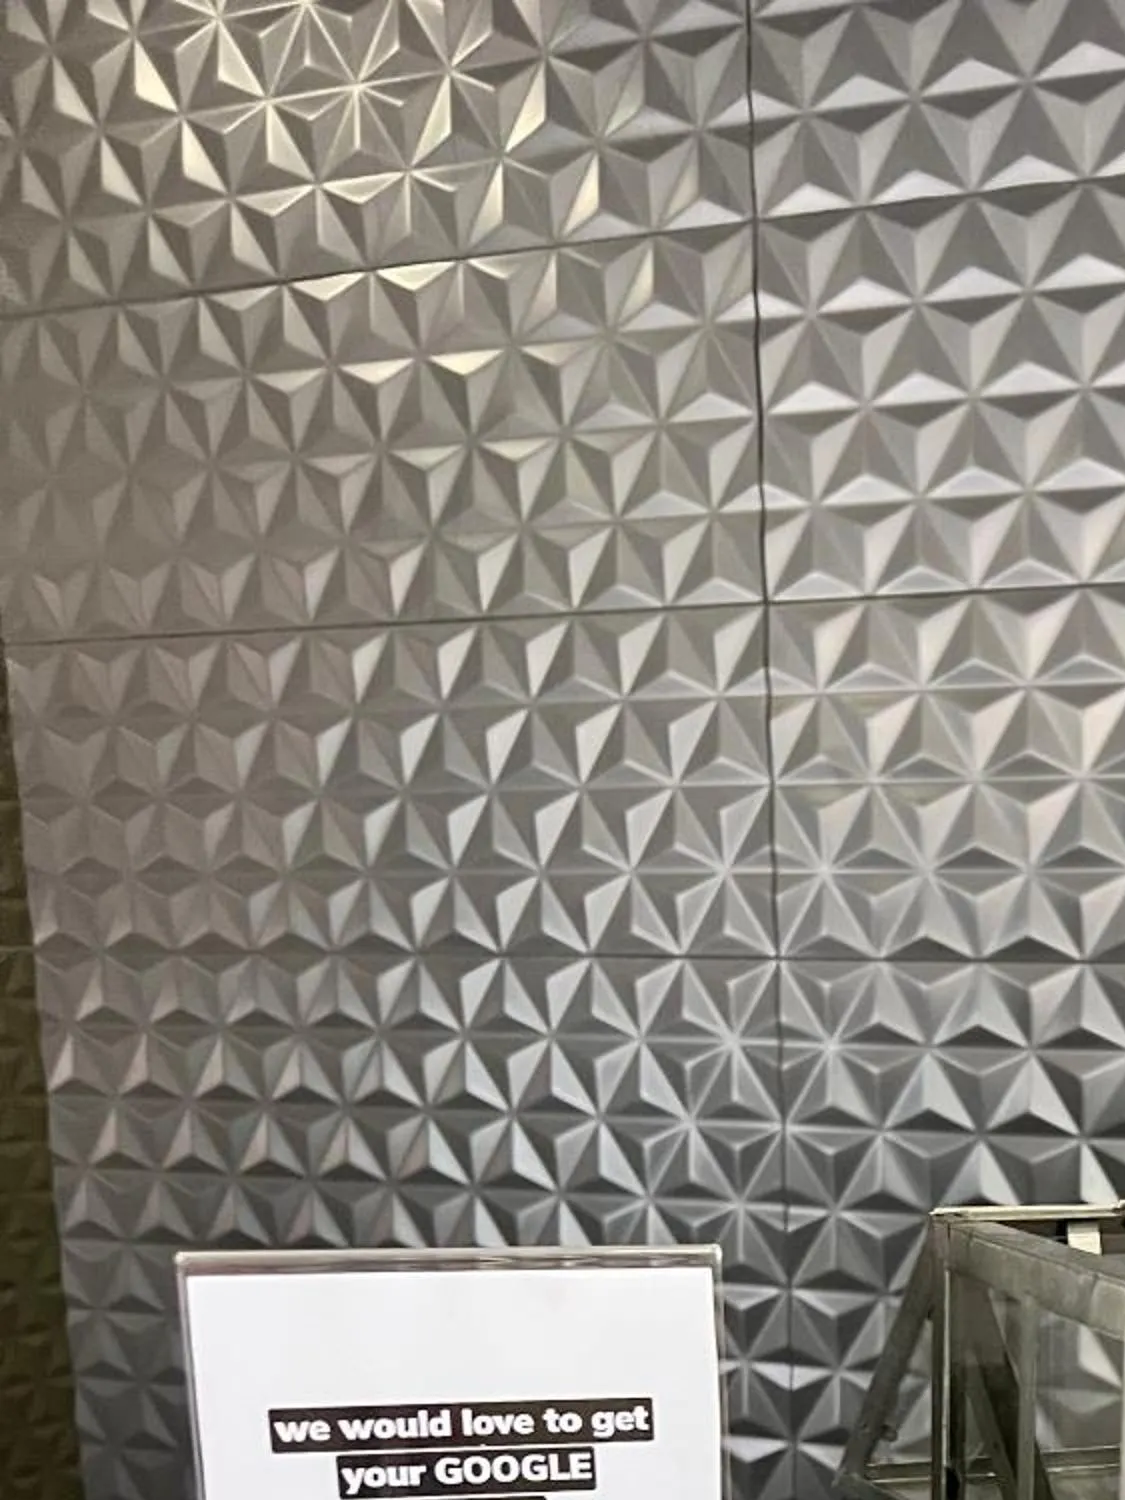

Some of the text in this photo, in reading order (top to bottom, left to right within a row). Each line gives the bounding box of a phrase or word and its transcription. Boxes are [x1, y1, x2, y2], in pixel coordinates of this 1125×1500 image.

[273, 1406, 649, 1442] we would love to get
[340, 1452, 593, 1495] your GOOGLE
